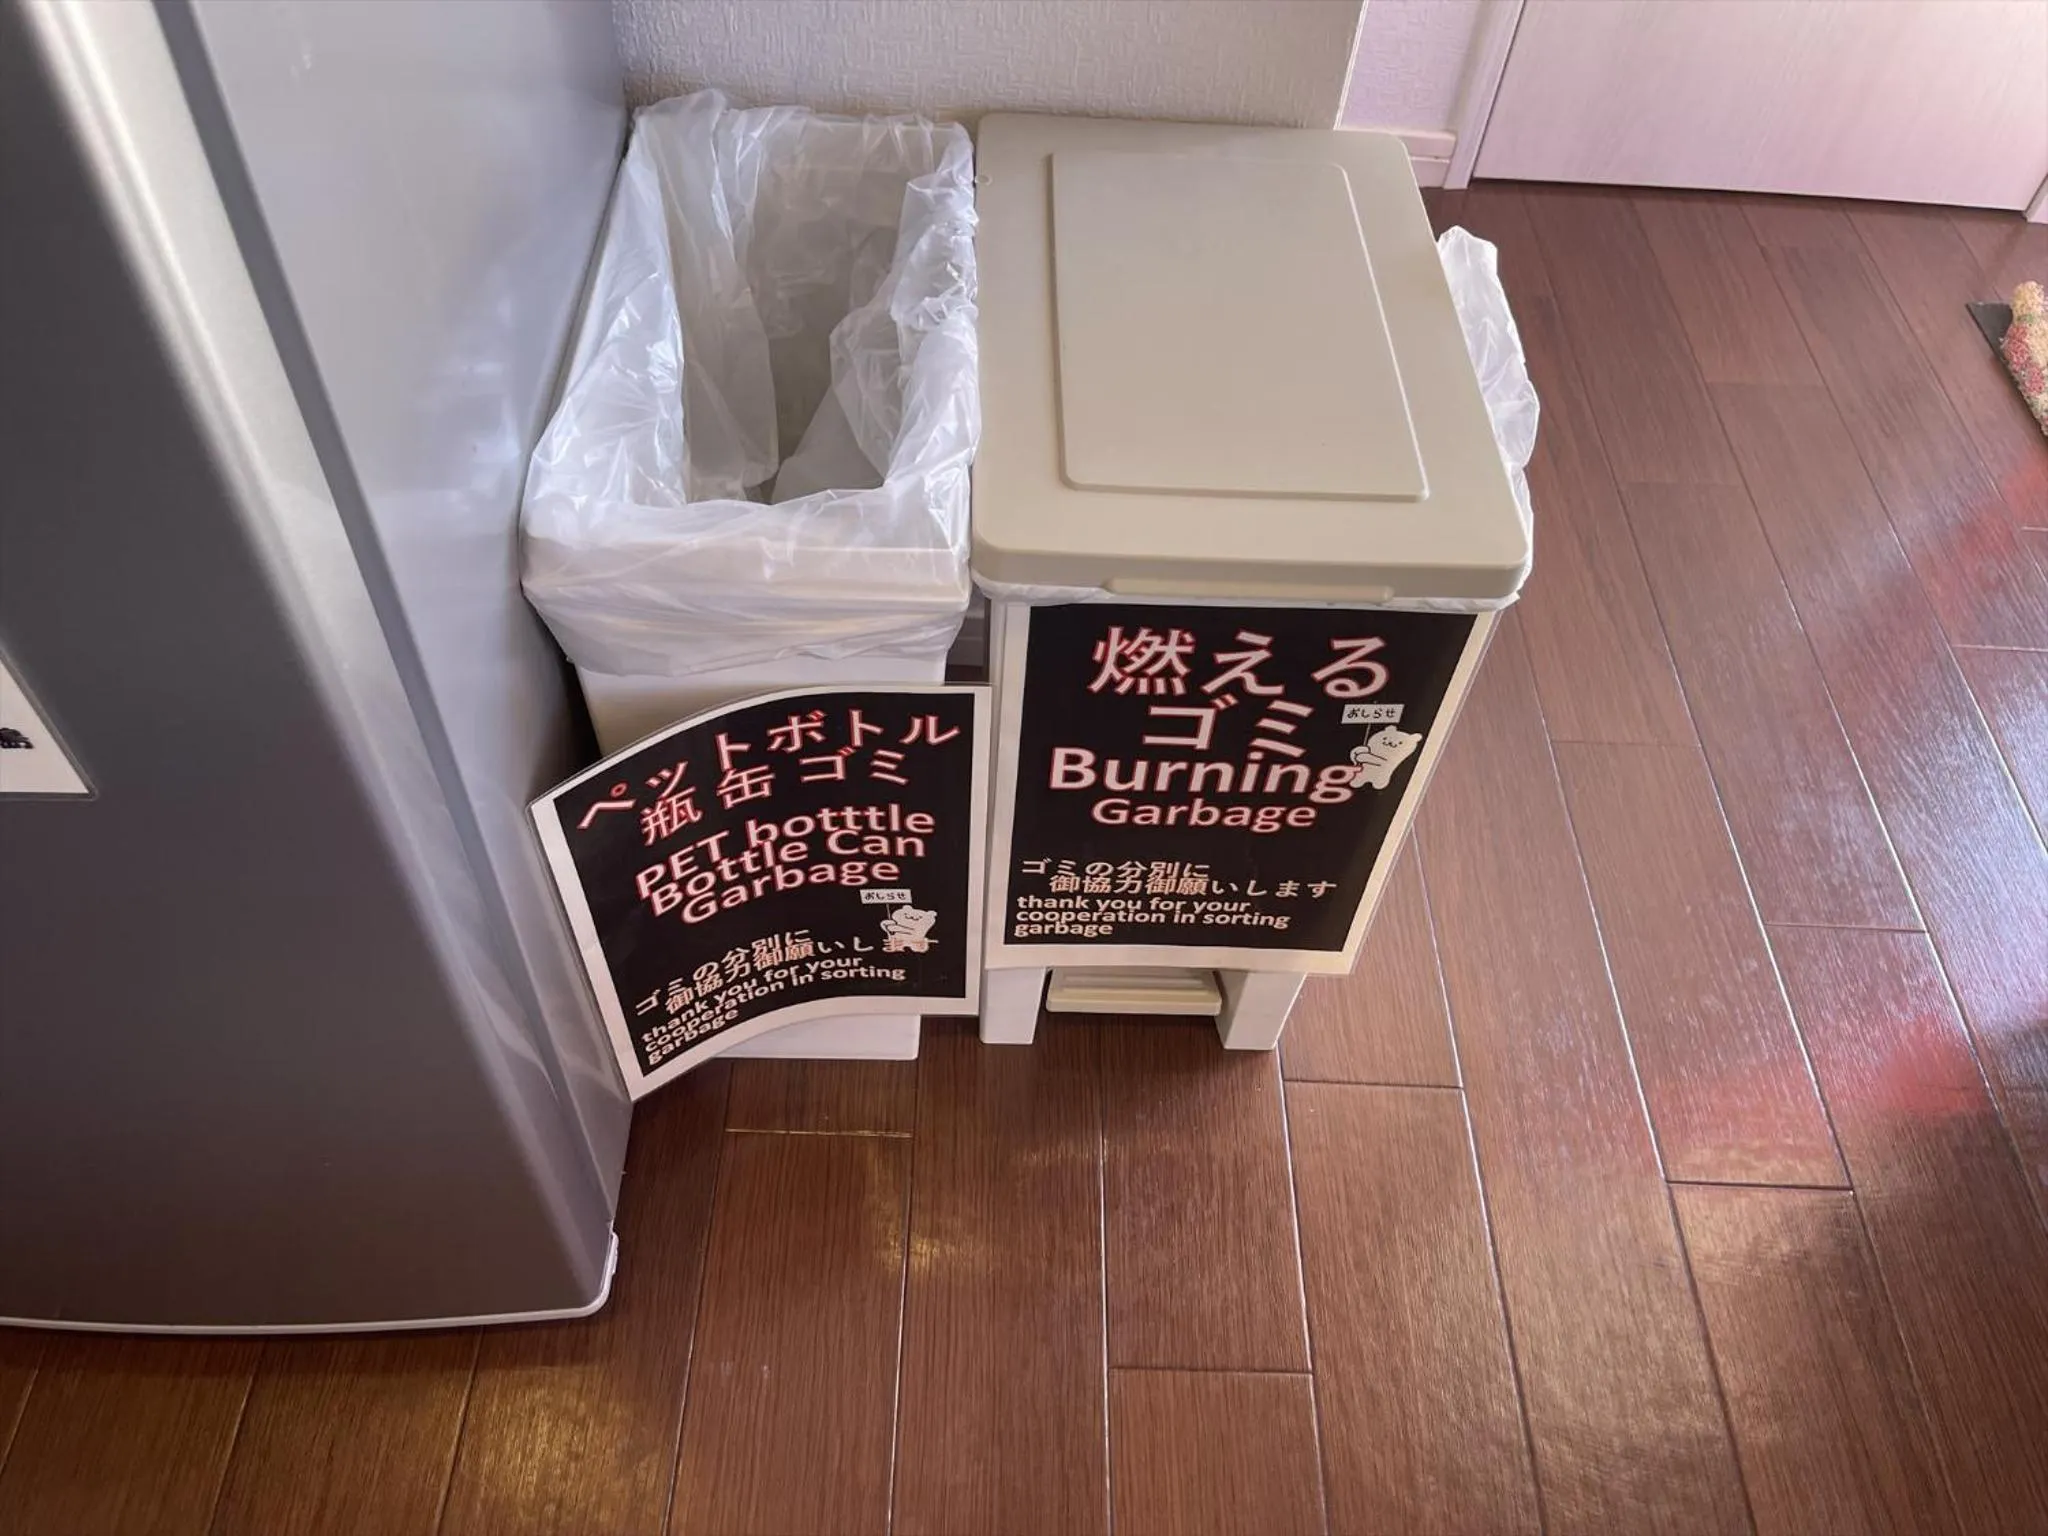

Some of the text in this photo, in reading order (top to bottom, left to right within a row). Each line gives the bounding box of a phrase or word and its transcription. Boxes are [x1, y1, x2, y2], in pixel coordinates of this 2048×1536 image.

[1087, 625, 1389, 698] 燃える
[1142, 693, 1314, 758] ゴミ
[1346, 706, 1397, 720] おしらせ
[577, 708, 961, 830] ペットボトル
[1049, 747, 1362, 803] Burning
[1091, 797, 1317, 834] Garbage
[636, 803, 936, 900] PET botttle
[651, 829, 926, 917] Bottle Can
[1022, 857, 1211, 879] ゴミの分別に
[681, 861, 900, 924] Garbage
[864, 891, 907, 901] おしらせ
[1017, 895, 1251, 915] thank you for your
[1049, 875, 1337, 898] 御協力御願いします
[1014, 921, 1114, 938] garbage
[1016, 910, 1290, 930] cooperation in sorting
[635, 929, 812, 1016] ゴミの分別に
[642, 956, 863, 1043] thank you for your
[645, 965, 906, 1052] cooperation in sorting
[648, 1009, 739, 1065] garbage
